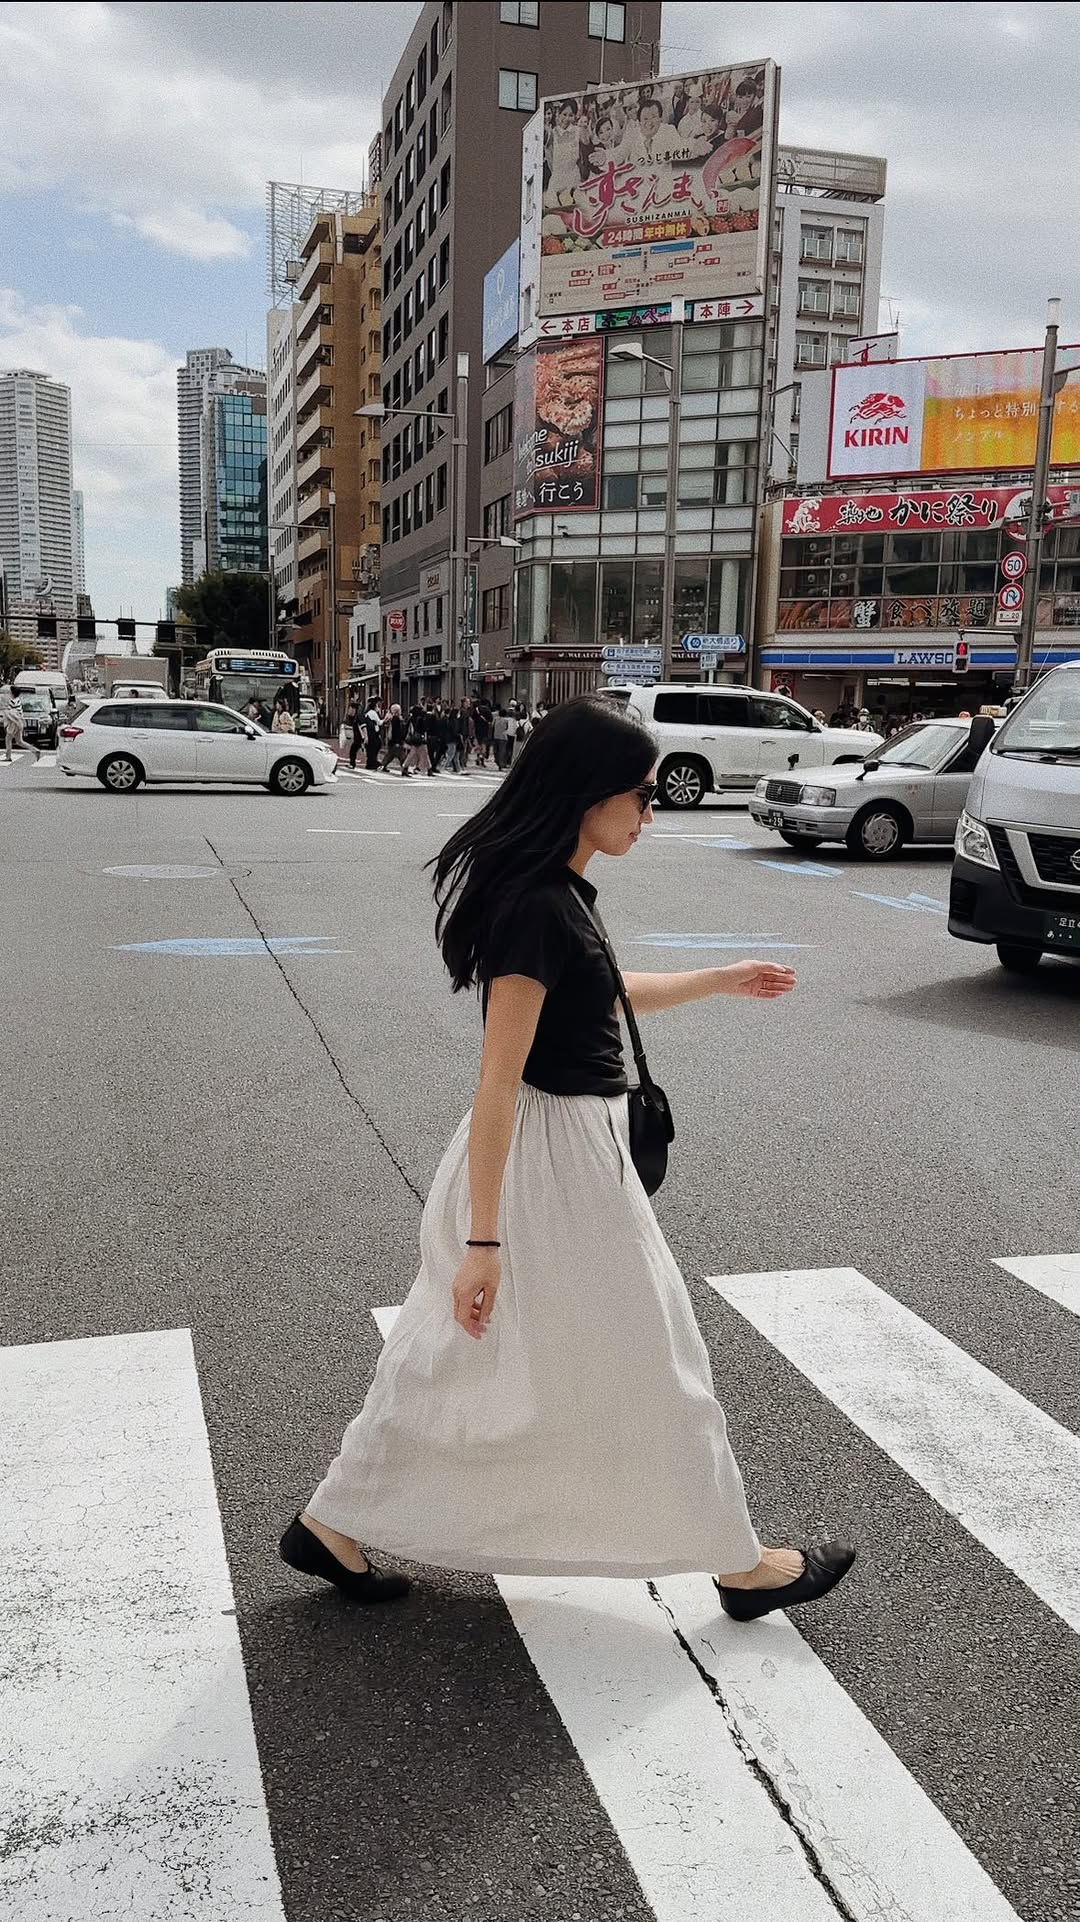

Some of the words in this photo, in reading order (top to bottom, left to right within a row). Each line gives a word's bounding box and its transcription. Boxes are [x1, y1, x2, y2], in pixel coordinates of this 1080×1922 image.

[626, 210, 691, 224] SUSHIZANMAI
[700, 302, 731, 318] 本陣
[562, 317, 590, 333] 本店
[844, 426, 909, 448] KIRIN
[1006, 559, 1021, 572] 50
[897, 652, 954, 665] LAWSO
